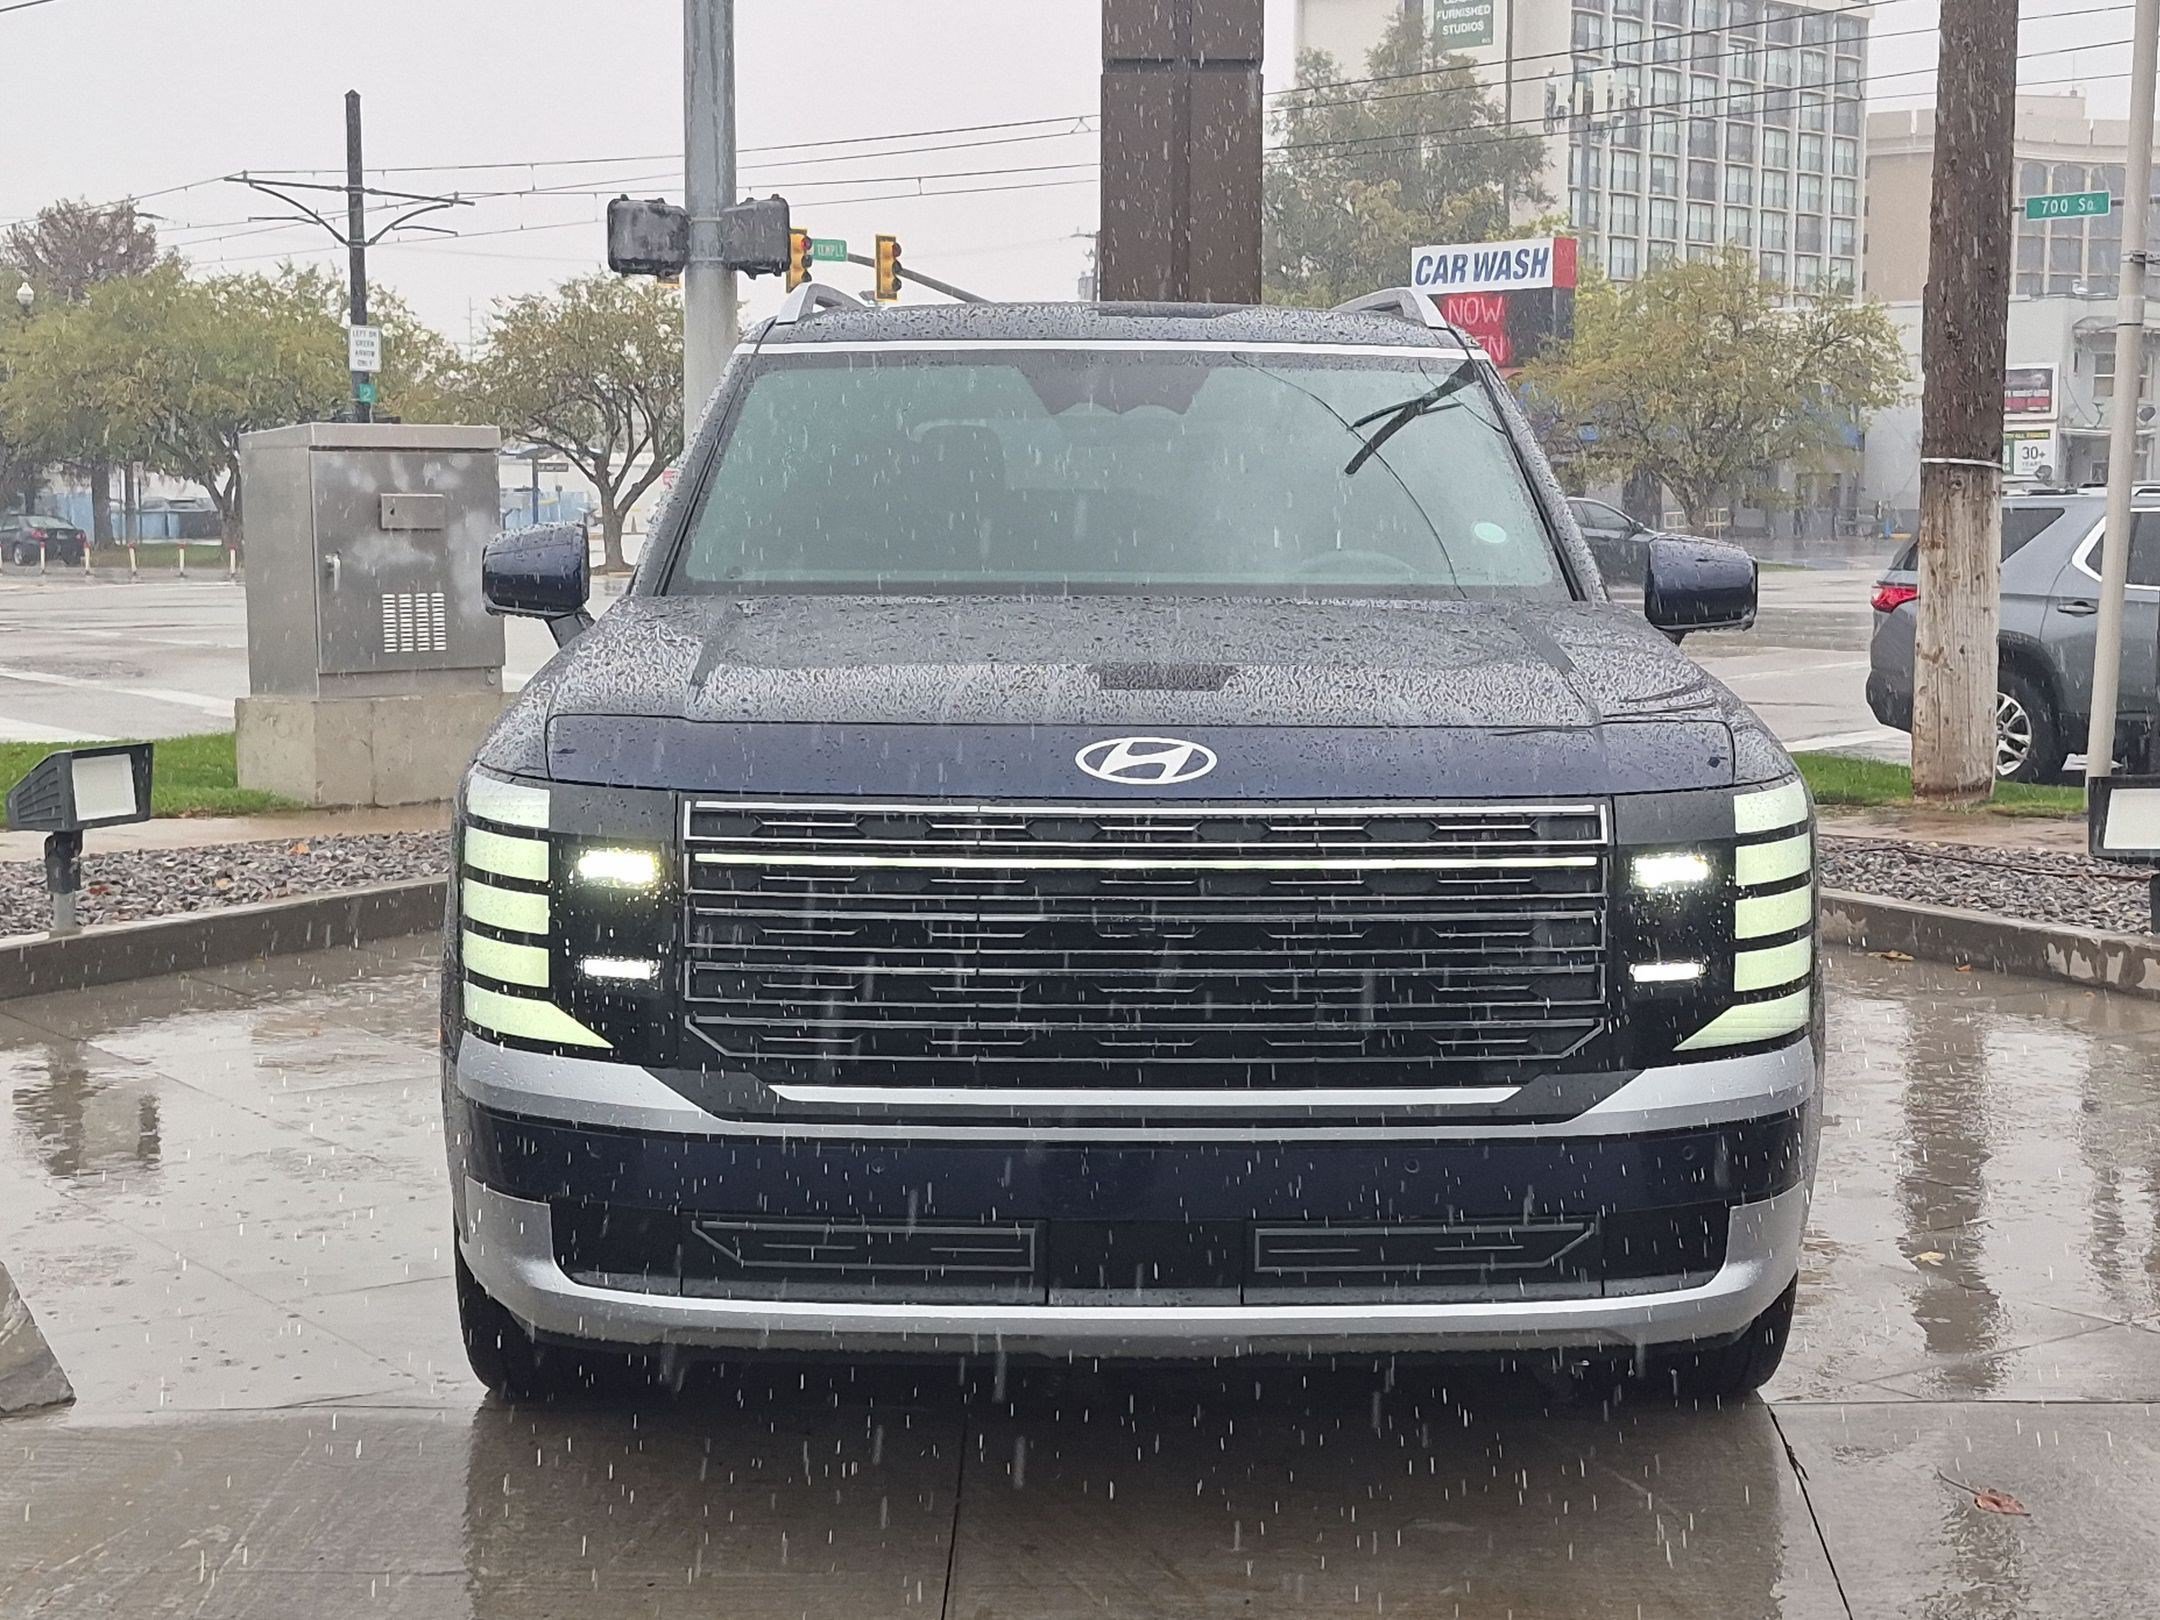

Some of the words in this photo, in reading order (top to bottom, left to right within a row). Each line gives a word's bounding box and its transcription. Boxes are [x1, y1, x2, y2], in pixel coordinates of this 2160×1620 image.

[1436, 4, 1491, 20] FURNISHED
[1442, 20, 1484, 35] STUDIOS
[2041, 199, 2068, 214] 700
[1415, 253, 1469, 286] CAR
[1473, 247, 1550, 282] WASH
[1448, 297, 1503, 324] NOW
[352, 329, 366, 337] LEFT
[2022, 446, 2046, 460] 30+
